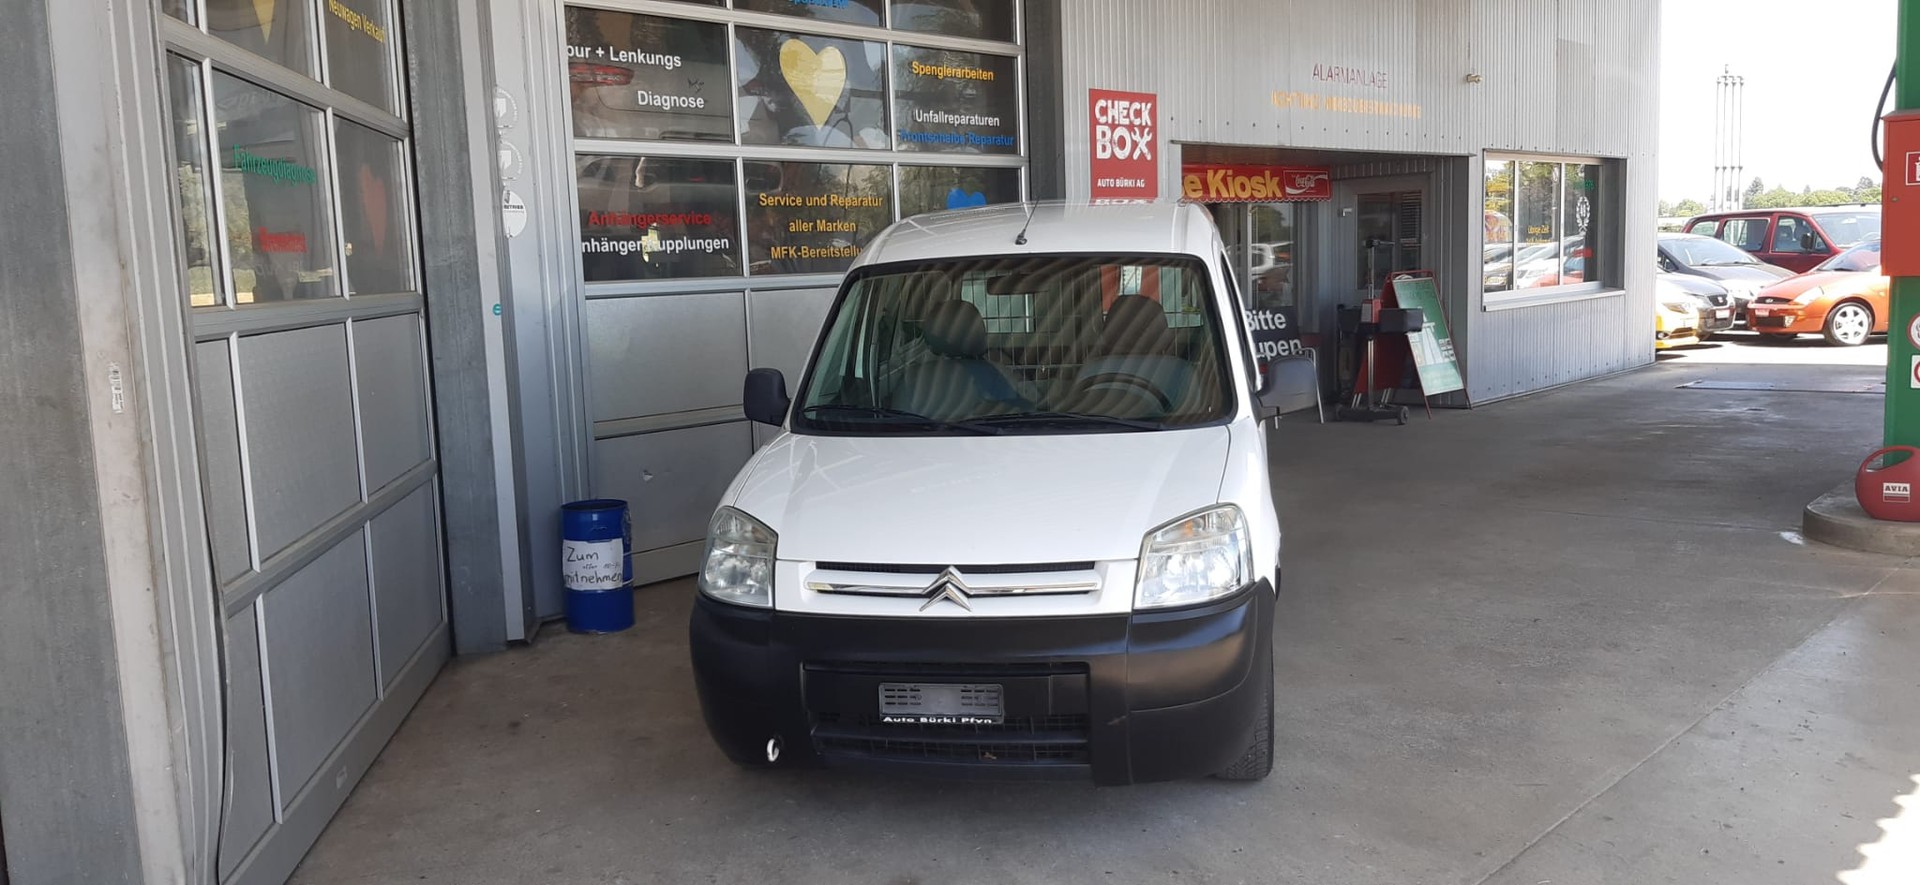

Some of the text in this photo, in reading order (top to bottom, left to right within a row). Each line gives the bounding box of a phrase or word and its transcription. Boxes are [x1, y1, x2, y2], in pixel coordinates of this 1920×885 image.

[595, 46, 605, 58] +
[610, 46, 682, 70] Lenkungs
[911, 62, 994, 81] Spenglerarbeiten
[1312, 63, 1388, 89] ALARMANLAGE
[638, 91, 705, 109] Diagnose
[914, 109, 1001, 127] Unfallreparaturen
[1094, 98, 1152, 126] CHECK
[1095, 124, 1153, 161] BOX
[1097, 177, 1146, 188] AUTO BÜRKI AG
[1182, 169, 1283, 199] e Kiosk
[758, 193, 884, 210] Service und Reparatur
[788, 219, 856, 233] aller Marken
[1245, 309, 1287, 331] Bitte
[566, 546, 599, 562] Zum
